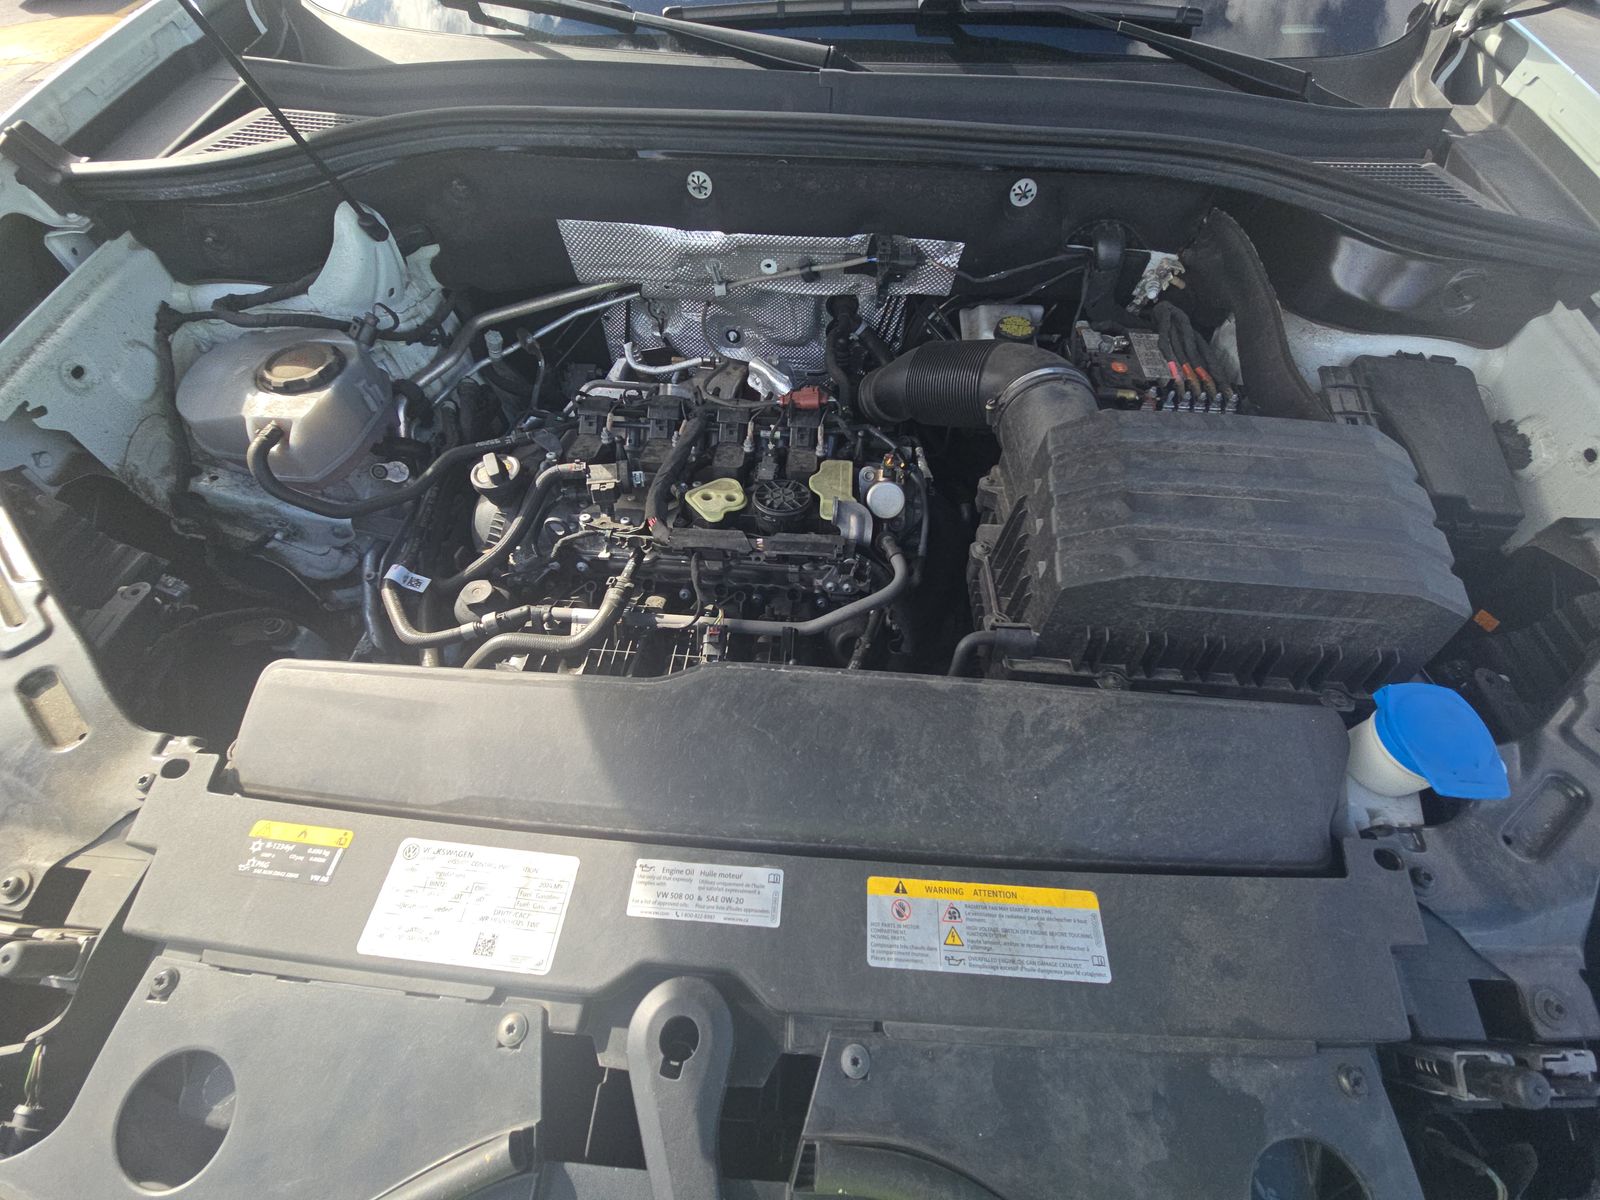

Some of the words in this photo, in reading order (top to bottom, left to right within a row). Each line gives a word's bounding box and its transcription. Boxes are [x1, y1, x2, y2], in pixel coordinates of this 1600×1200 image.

[662, 867, 684, 876] Engine
[685, 868, 695, 876] Oil
[700, 869, 717, 878] Huile
[718, 872, 743, 880] moteur
[924, 885, 964, 896] WARNING
[973, 888, 1018, 899] ATTENTION
[656, 891, 669, 899] VW
[670, 891, 683, 900] 508
[684, 892, 694, 901] 00
[697, 894, 703, 902] &
[705, 894, 718, 902] SAE
[720, 896, 745, 905] 0W-20
